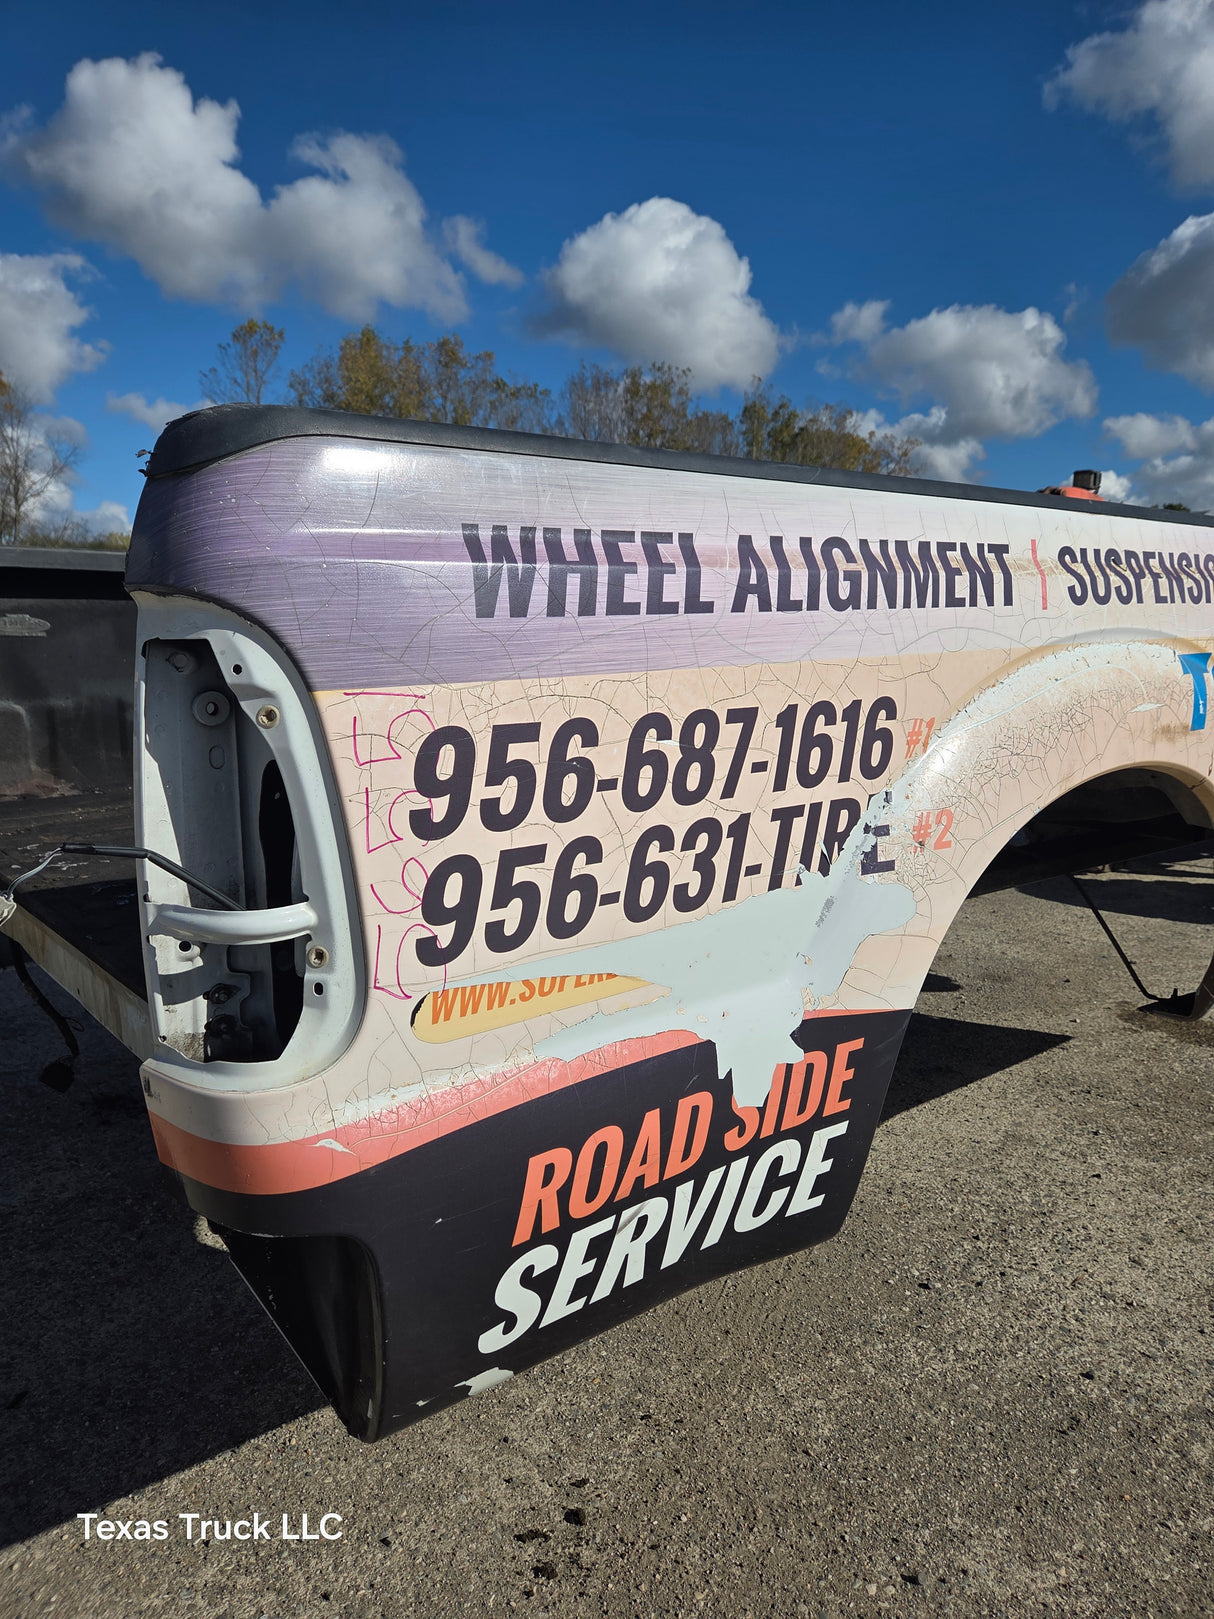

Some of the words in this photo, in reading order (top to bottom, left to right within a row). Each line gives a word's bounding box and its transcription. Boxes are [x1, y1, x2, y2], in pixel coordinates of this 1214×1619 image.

[461, 523, 715, 618] WHEEL
[730, 534, 1014, 613] ALIGNMENT
[409, 696, 898, 841] 956-687-1616
[904, 716, 936, 759] #1
[912, 808, 955, 854] #2
[478, 1120, 850, 1354] SERVICE
[512, 1090, 715, 1248] ROAD
